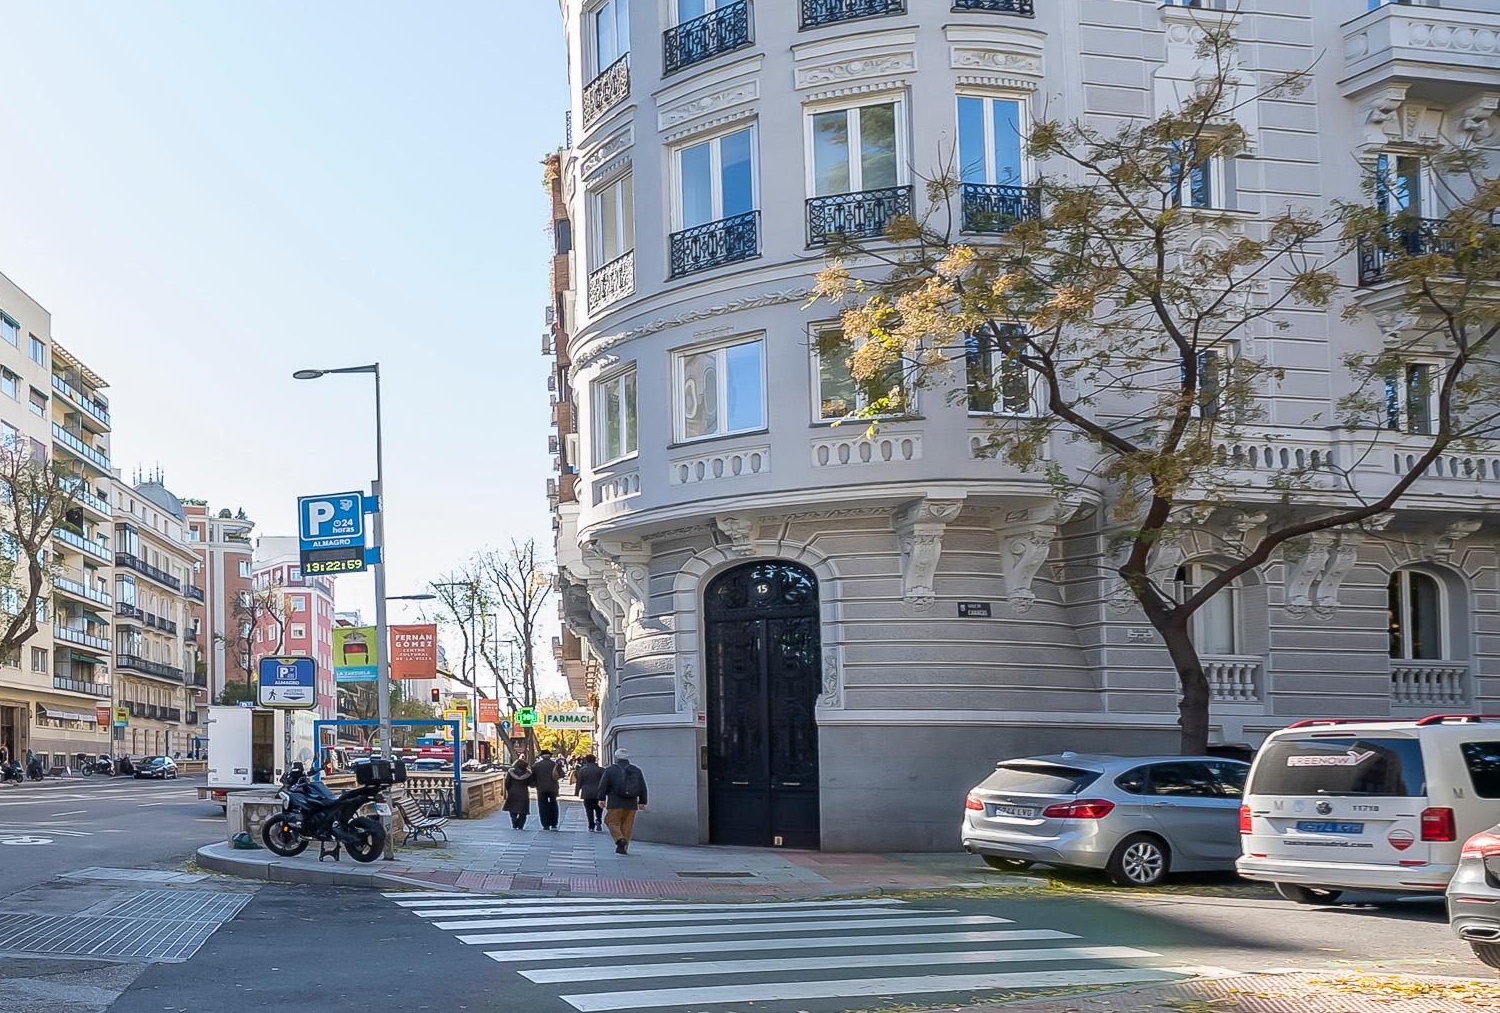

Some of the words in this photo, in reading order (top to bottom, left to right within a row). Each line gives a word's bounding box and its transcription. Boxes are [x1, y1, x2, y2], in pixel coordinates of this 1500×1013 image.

[308, 501, 335, 536] P
[341, 518, 353, 527] 24
[332, 526, 355, 534] horas
[312, 538, 351, 547] ALMAGRO
[306, 559, 362, 572] 13:22:59
[756, 584, 768, 594] 15
[280, 667, 289, 678] P
